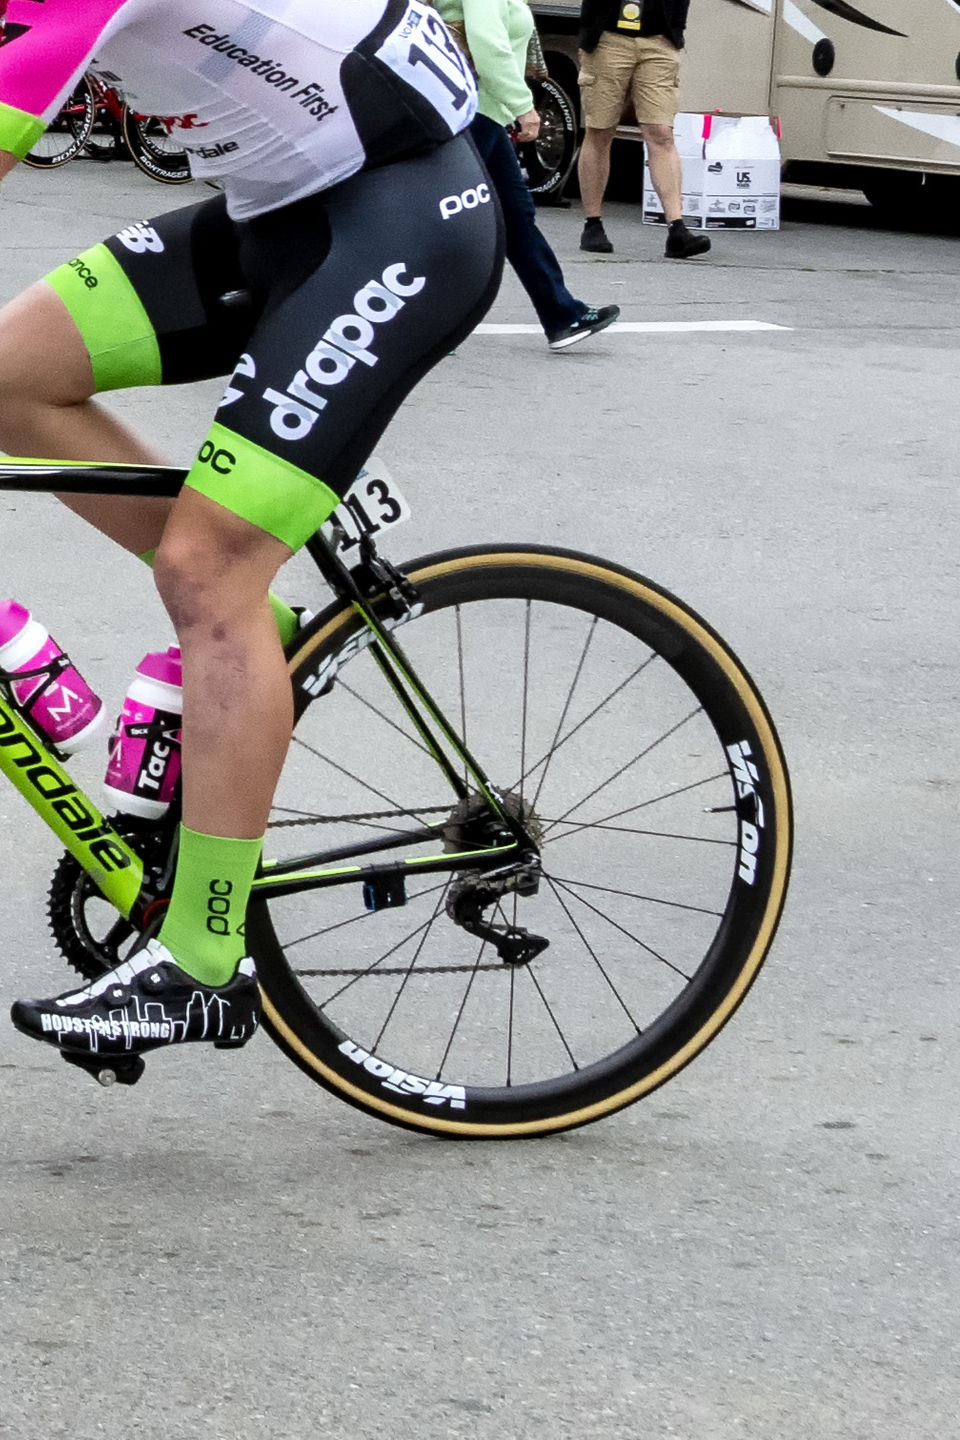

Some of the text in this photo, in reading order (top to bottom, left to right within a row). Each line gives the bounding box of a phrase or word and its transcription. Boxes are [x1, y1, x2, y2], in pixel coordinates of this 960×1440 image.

[182, 23, 339, 122] Education First
[262, 262, 427, 442] drapac
